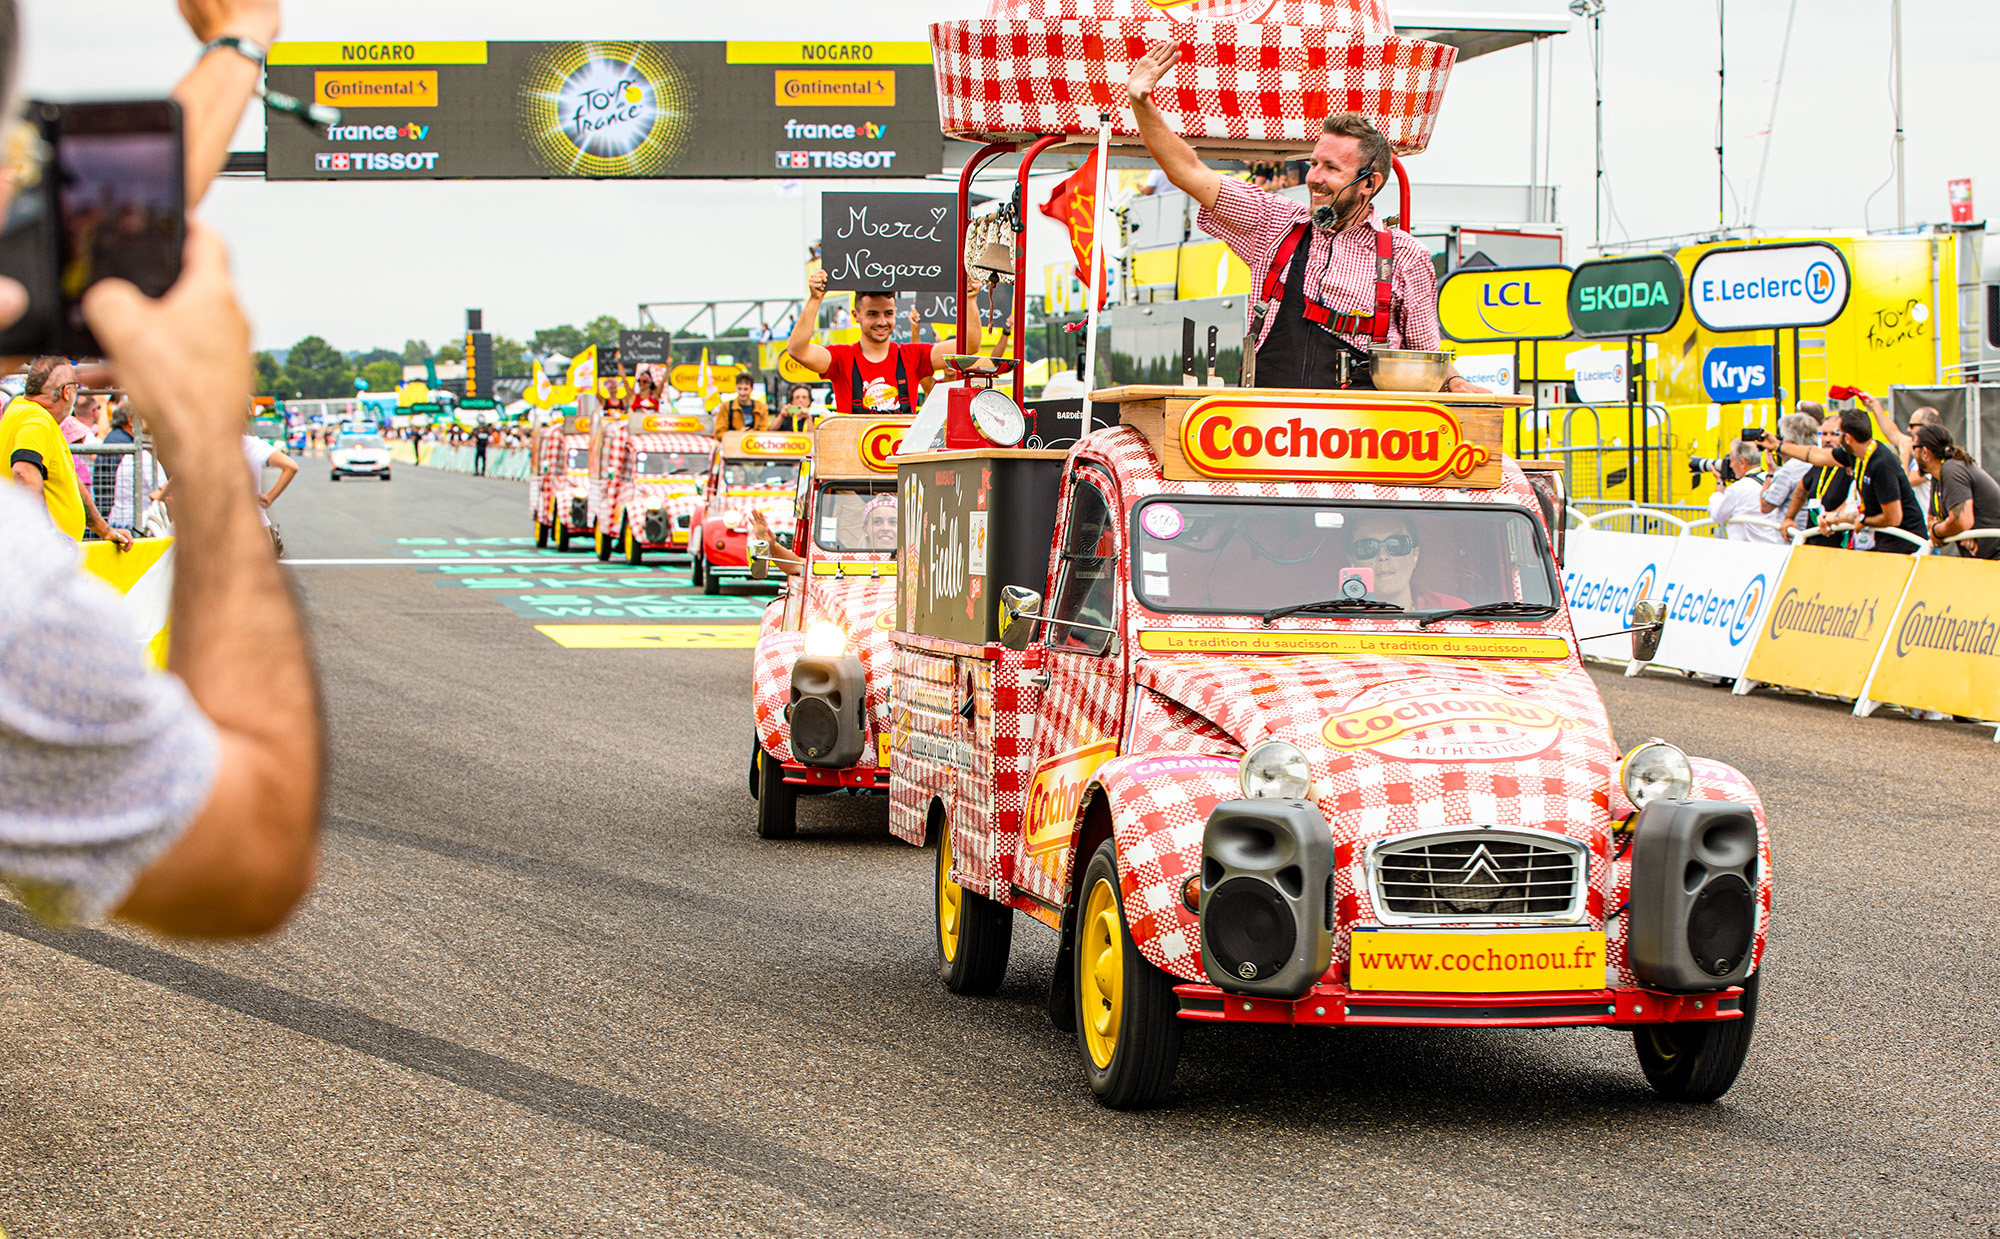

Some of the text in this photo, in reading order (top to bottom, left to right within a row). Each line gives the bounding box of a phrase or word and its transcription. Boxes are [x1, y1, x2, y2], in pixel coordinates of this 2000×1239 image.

[342, 45, 414, 60] NOGARO
[802, 45, 873, 60] NOGARO
[324, 80, 413, 98] Continental
[784, 79, 871, 98] Continental
[350, 152, 439, 170] TISSOT
[809, 151, 896, 169] TISSOT
[837, 206, 943, 242] Merci
[831, 249, 942, 288] Nogaro
[1484, 282, 1541, 306] LCL
[1579, 281, 1669, 311] SKODA
[1703, 277, 1802, 302] E.Leclerc
[1710, 361, 1766, 393] Krys
[745, 438, 806, 450] Cochonou
[1199, 415, 1438, 461] Cochonou
[930, 516, 964, 613] Ficelle
[1770, 588, 1868, 640] Continental
[1168, 637, 1183, 647] La
[1188, 637, 1246, 648] tradition
[1253, 637, 1269, 648] du
[1275, 638, 1338, 649] saucisson
[1360, 640, 1375, 650] La
[1380, 640, 1438, 651] tradition
[1443, 641, 1460, 652] du
[1464, 642, 1527, 653] saucisson
[1335, 699, 1543, 739] Cochonou
[1359, 946, 1597, 971] www.cochonou.fr
